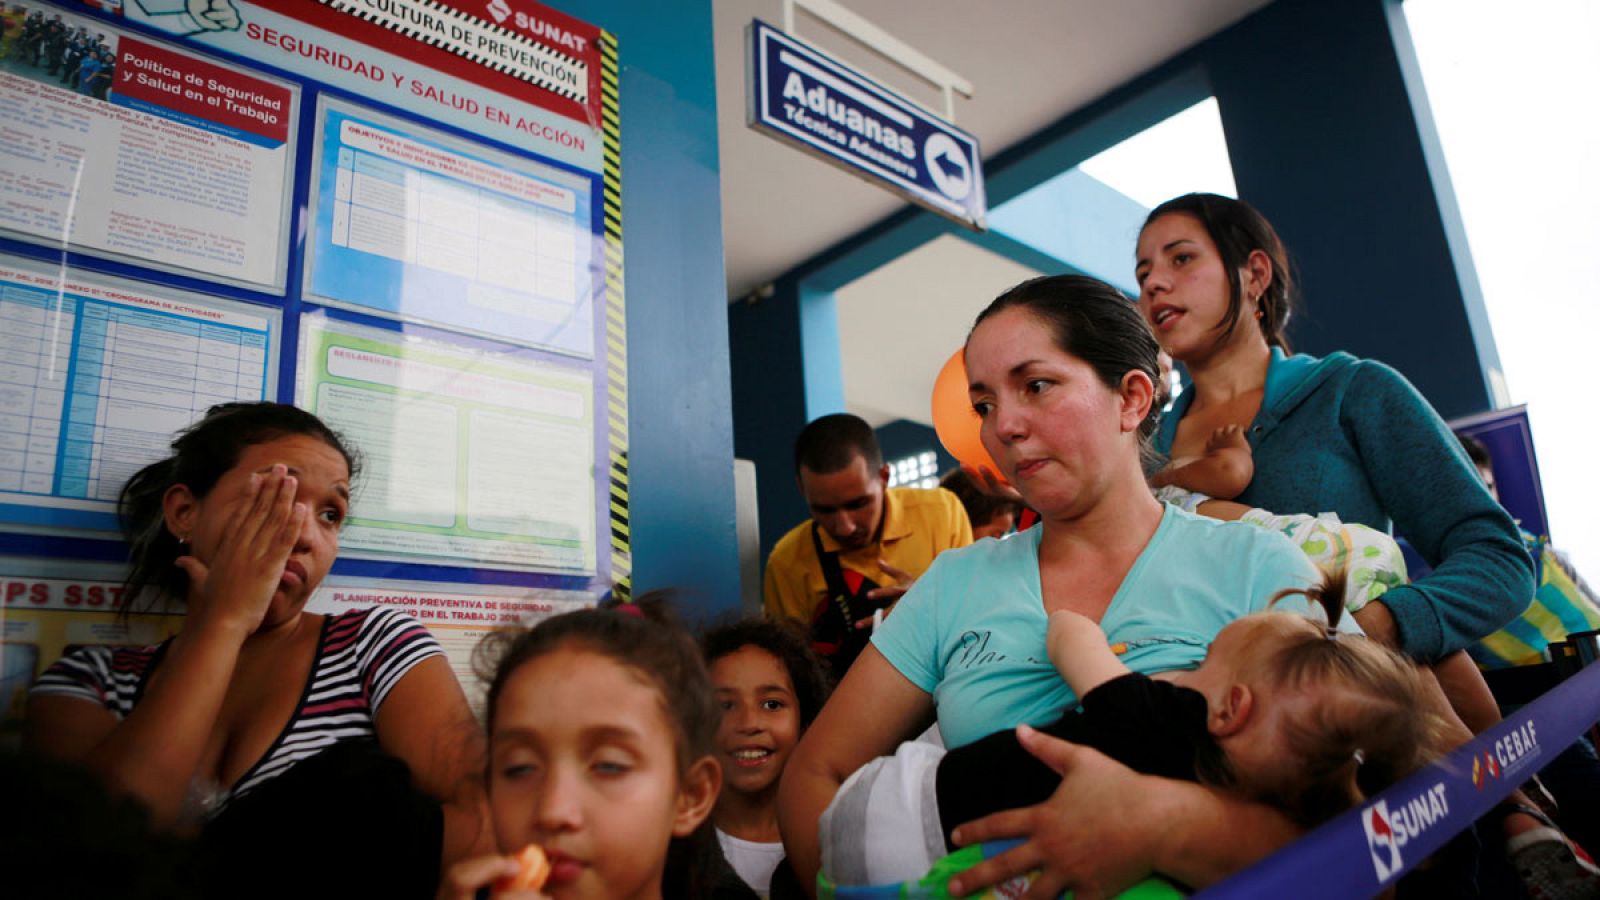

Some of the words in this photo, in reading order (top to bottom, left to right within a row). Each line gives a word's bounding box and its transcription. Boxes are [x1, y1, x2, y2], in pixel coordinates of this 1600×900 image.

[451, 25, 473, 46] DE
[477, 35, 578, 86] PREVENCIÓN
[514, 11, 587, 52] SUNAT
[122, 70, 133, 82] y
[137, 73, 181, 95] Salud
[184, 89, 204, 102] en
[207, 94, 221, 107] el
[223, 99, 278, 125] Trabajo
[123, 52, 181, 80] Política
[184, 73, 204, 87] de
[207, 78, 281, 111] Seguridad
[245, 22, 385, 82] SEGURIDAD
[391, 72, 405, 89] Y
[410, 79, 480, 115] SALUD
[485, 105, 511, 127] EN
[515, 117, 586, 152] ACCIÓN
[782, 71, 917, 160] Aduanas
[783, 103, 847, 145] Técnica
[64, 583, 128, 608] SST
[333, 592, 417, 606] PLANIFICACIÓN
[419, 597, 483, 610] PREVENTIVA
[485, 601, 497, 610] DE
[499, 601, 553, 613] SEGURIDAD
[420, 610, 434, 619] EN
[436, 611, 449, 619] EL
[452, 611, 497, 621] TRABAJO
[1495, 719, 1537, 768] CEBAF
[1391, 782, 1449, 848] SUNAT
